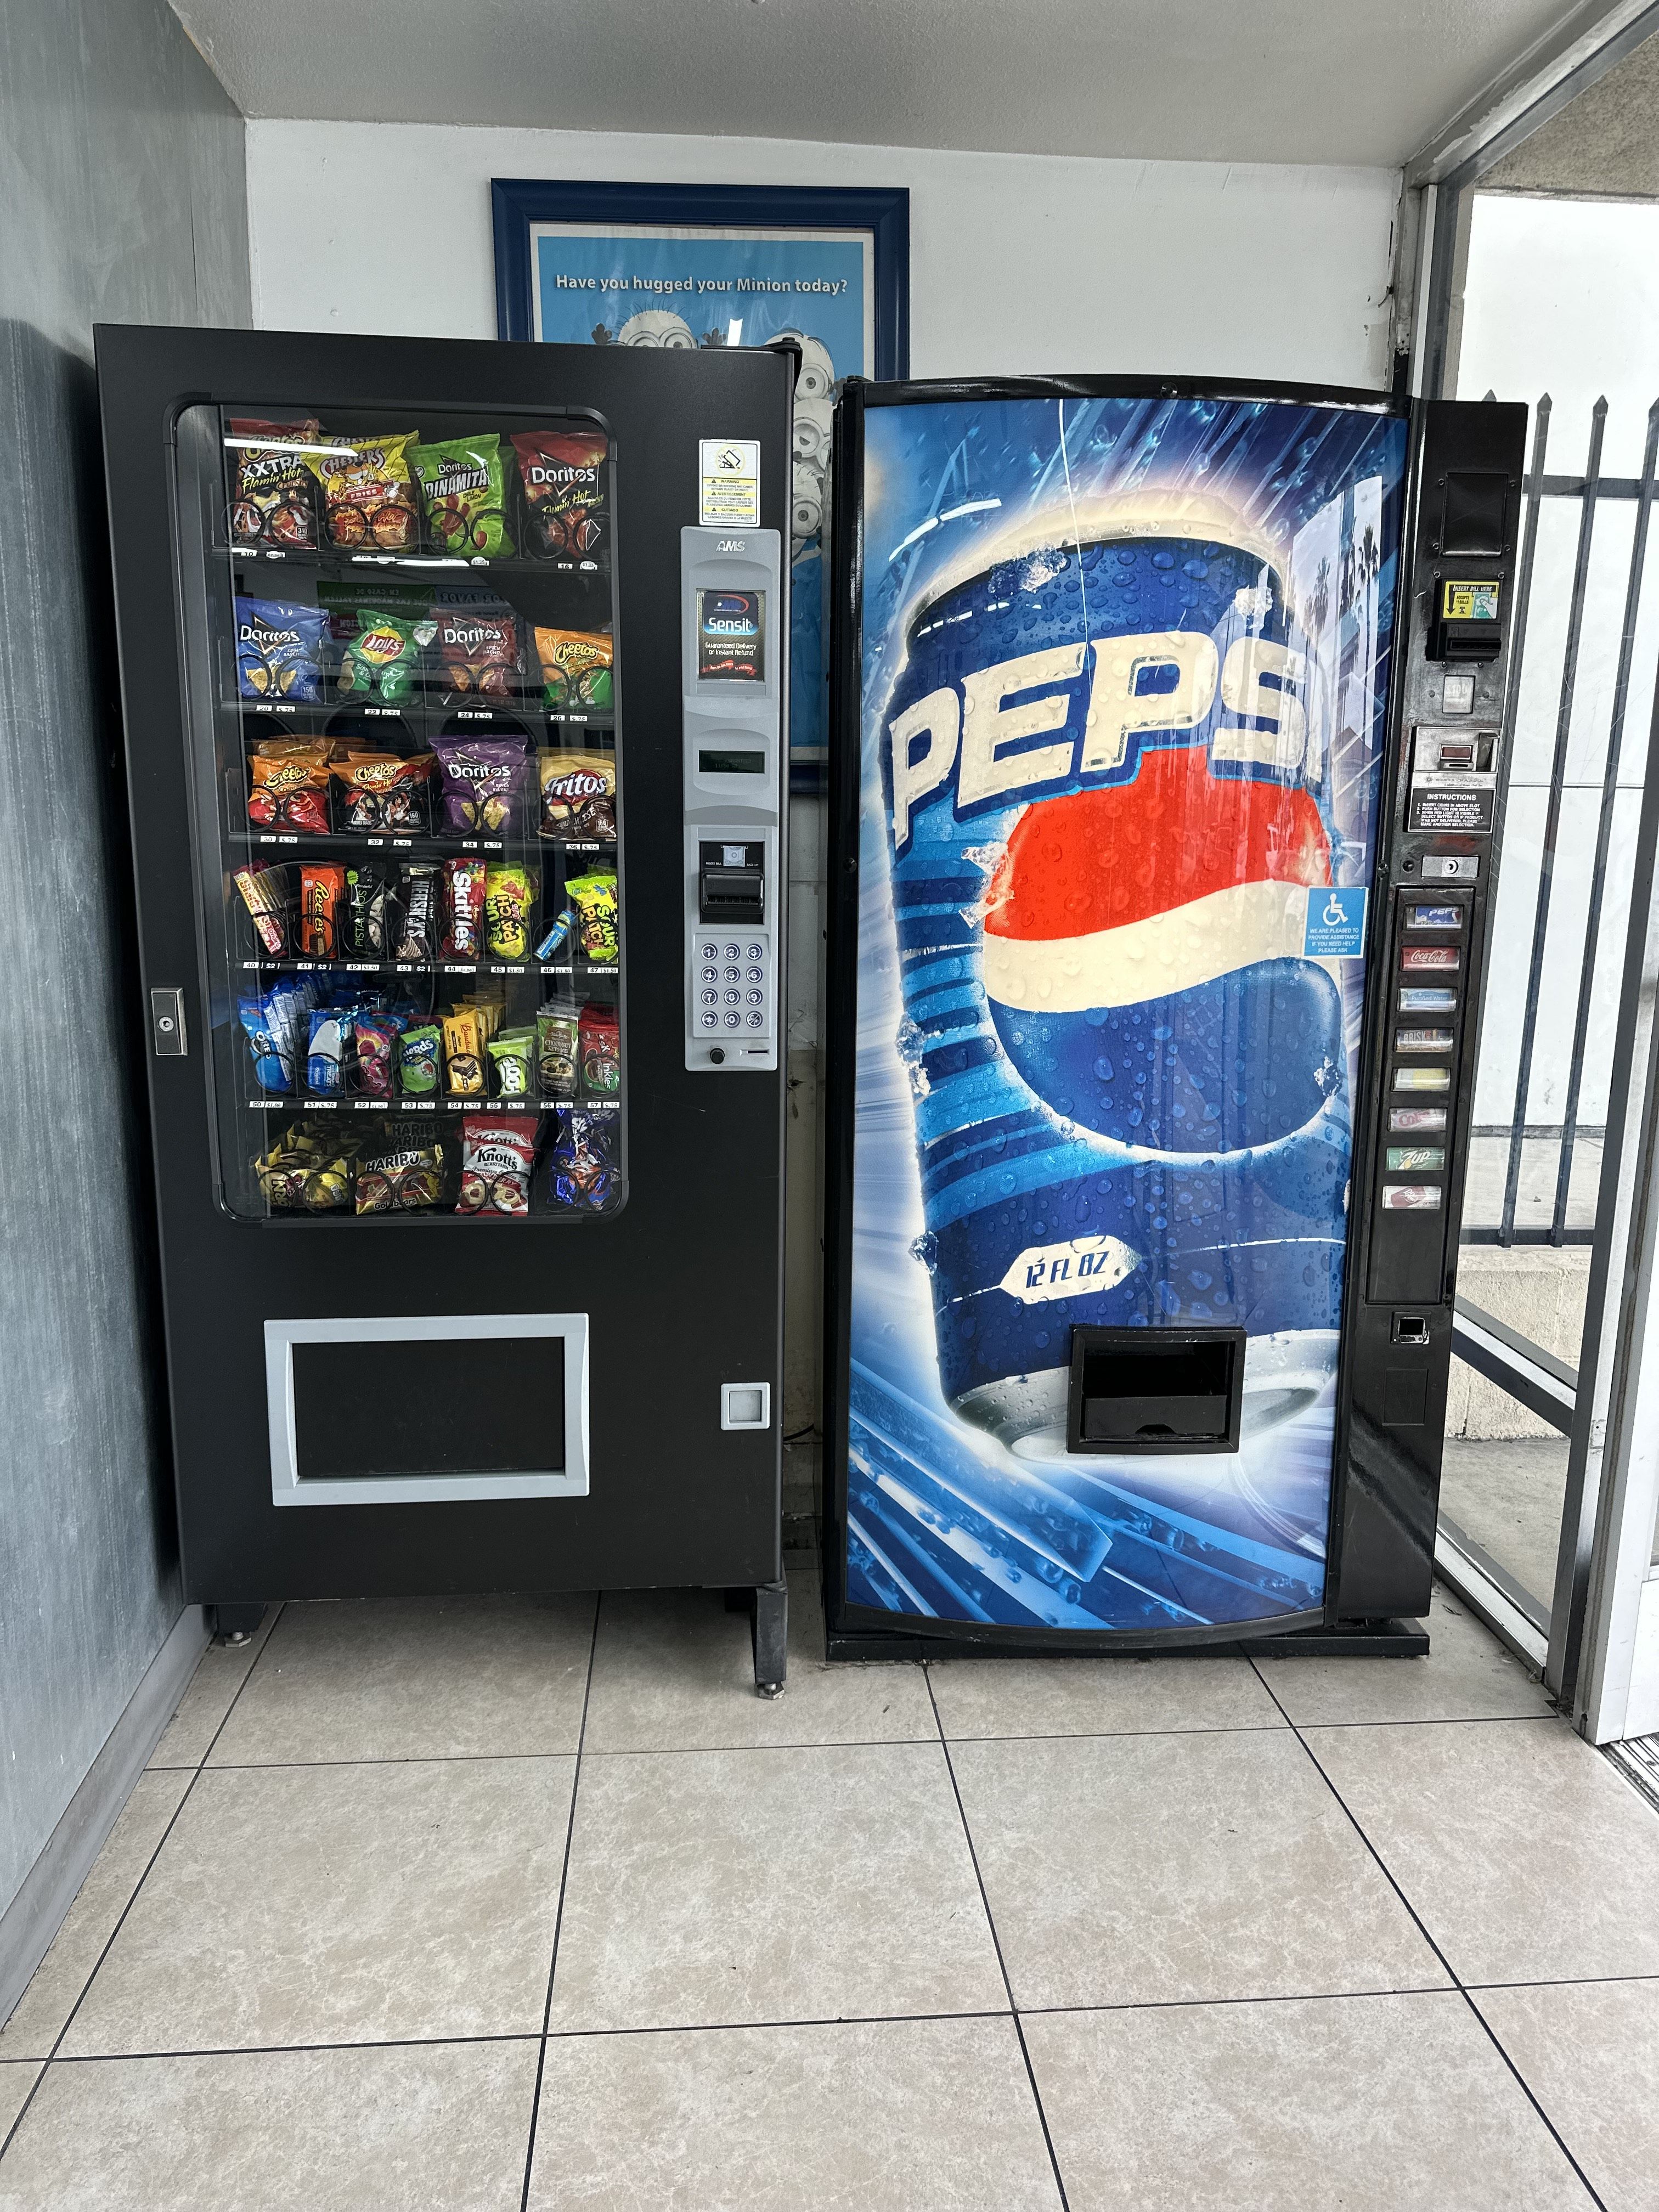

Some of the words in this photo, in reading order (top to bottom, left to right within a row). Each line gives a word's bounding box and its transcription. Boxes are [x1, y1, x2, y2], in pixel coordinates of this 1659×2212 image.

[556, 274, 596, 288] Have
[600, 279, 629, 292] you
[633, 275, 693, 294] hugged
[697, 280, 732, 294] your
[737, 277, 791, 292] Minion
[795, 278, 848, 296] today?
[241, 455, 305, 479] XXTRA
[281, 466, 304, 481] Hot
[438, 463, 472, 474] Doritos
[532, 466, 595, 483] Doritos
[351, 489, 377, 499] FRIES
[425, 469, 488, 500] DINAMITA
[572, 489, 591, 504] Hot
[716, 540, 745, 552] AMS
[240, 625, 300, 642] Doritos
[709, 617, 752, 632] Sensit
[444, 628, 501, 644] Doritos
[555, 642, 599, 663] Cheetos
[357, 763, 396, 781] Cheetos
[448, 764, 511, 778] Doritos
[545, 773, 607, 805] Fritos
[407, 880, 430, 938] HERSHEY'S
[453, 871, 473, 950] Skittles
[496, 894, 518, 943] PATCH
[486, 897, 503, 941] SOUR
[597, 905, 615, 947] SOUR
[1410, 950, 1449, 963] Coca-Cola
[255, 1031, 271, 1059] OREO
[545, 1040, 571, 1049] CHOCONUT
[392, 1122, 443, 1136] HARIBO
[366, 1152, 420, 1172] HARIBO
[477, 1147, 518, 1170] Knott's
[1026, 1263, 1045, 1288] 12
[1050, 1258, 1072, 1283] FL
[1078, 1251, 1109, 1277] OZ
